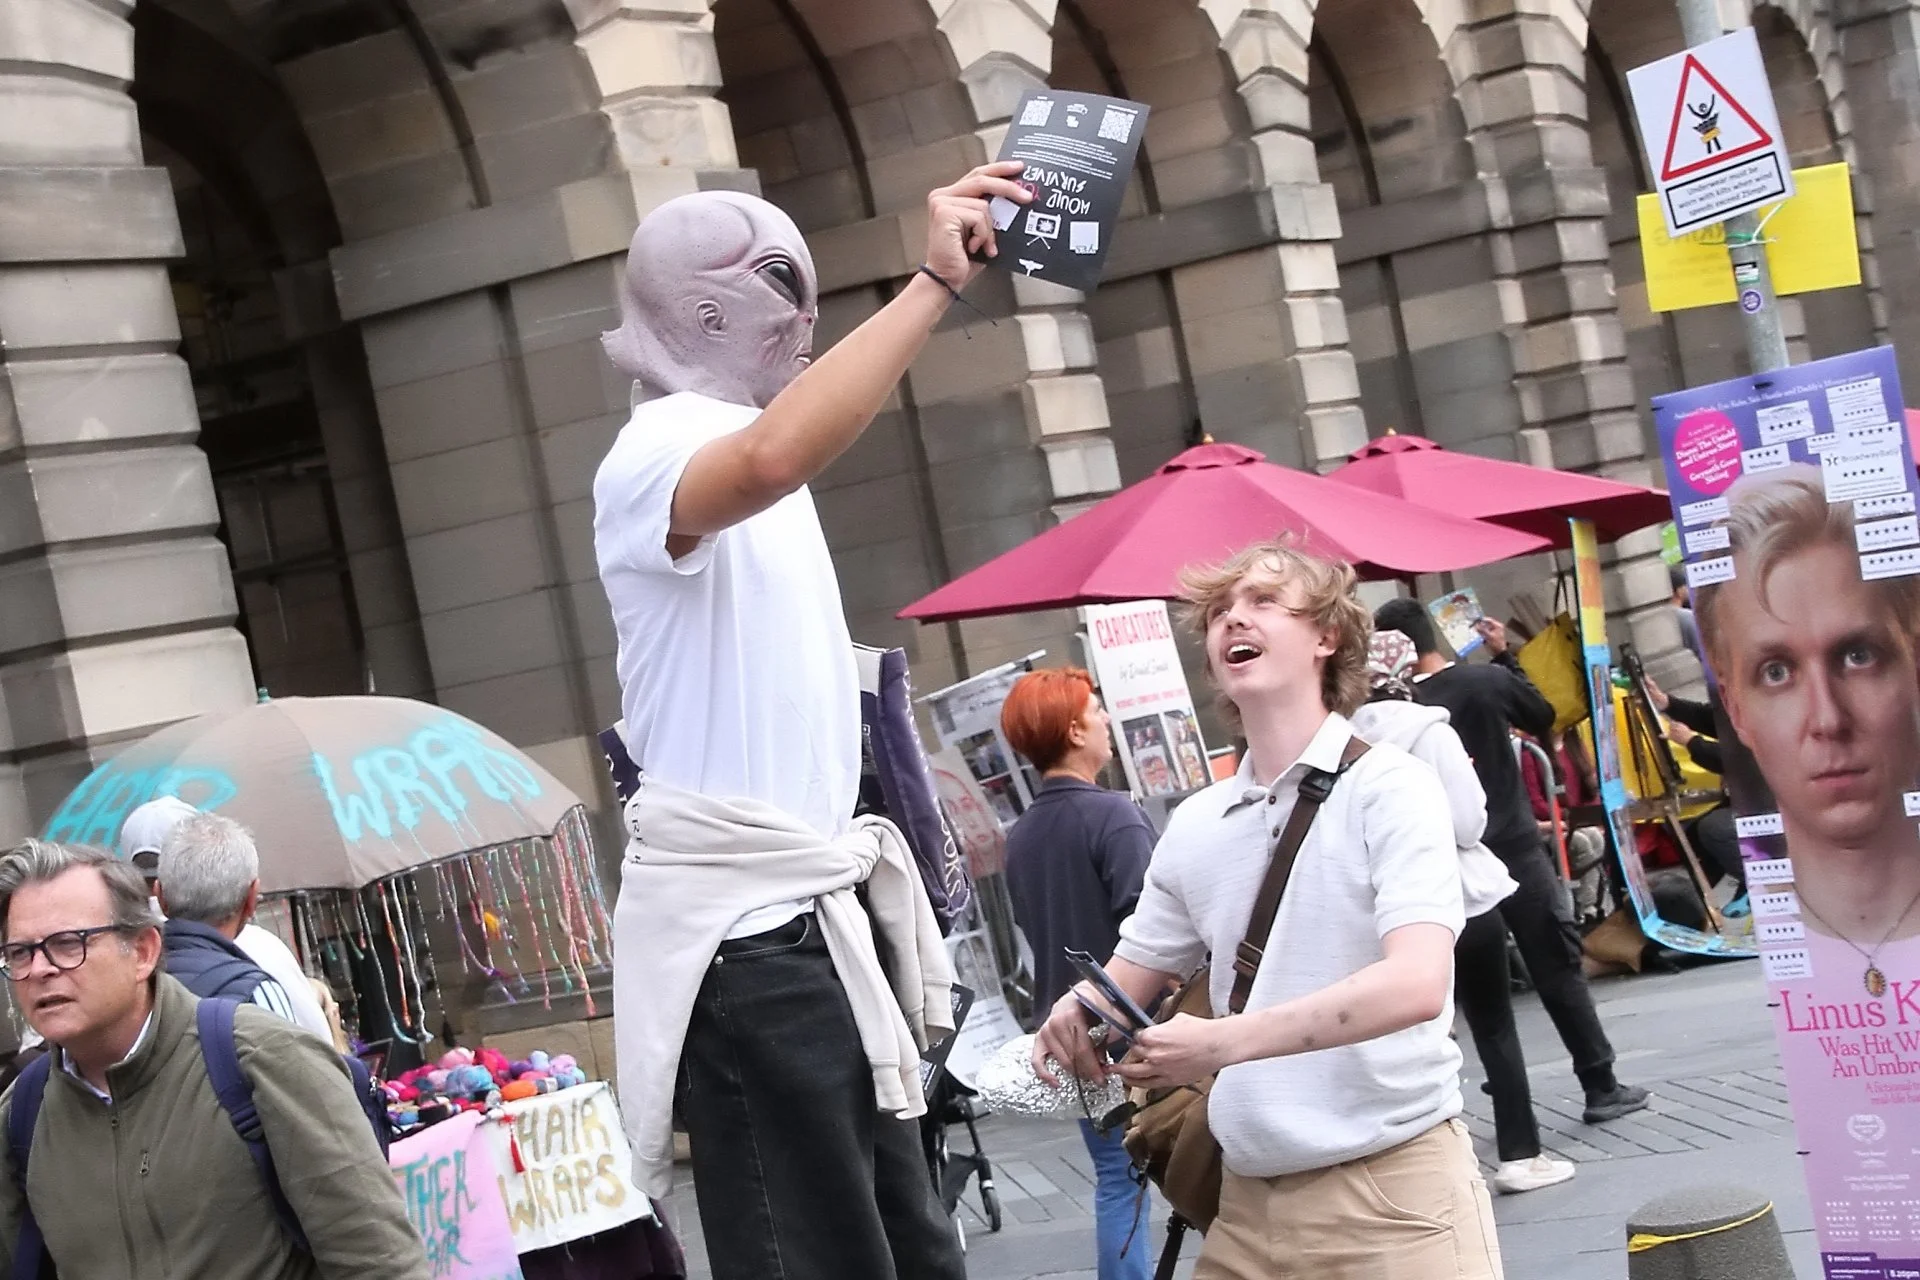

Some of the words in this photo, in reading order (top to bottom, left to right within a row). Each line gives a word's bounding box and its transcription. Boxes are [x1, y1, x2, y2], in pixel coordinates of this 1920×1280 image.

[1023, 165, 1087, 193] SURVIVE?
[1046, 189, 1090, 215] WOULD
[1095, 609, 1169, 649] CARICATURES
[1780, 990, 1887, 1032] Linus
[1890, 980, 1920, 1025] K
[1818, 1035, 1861, 1057] Was
[1861, 1033, 1895, 1055] Hit
[1894, 1030, 1920, 1052] W
[1832, 1058, 1860, 1078] An
[1860, 1053, 1920, 1076] Umbr
[516, 1097, 612, 1162] HAIR
[392, 1150, 477, 1237] THER
[497, 1153, 627, 1235] WRAPS
